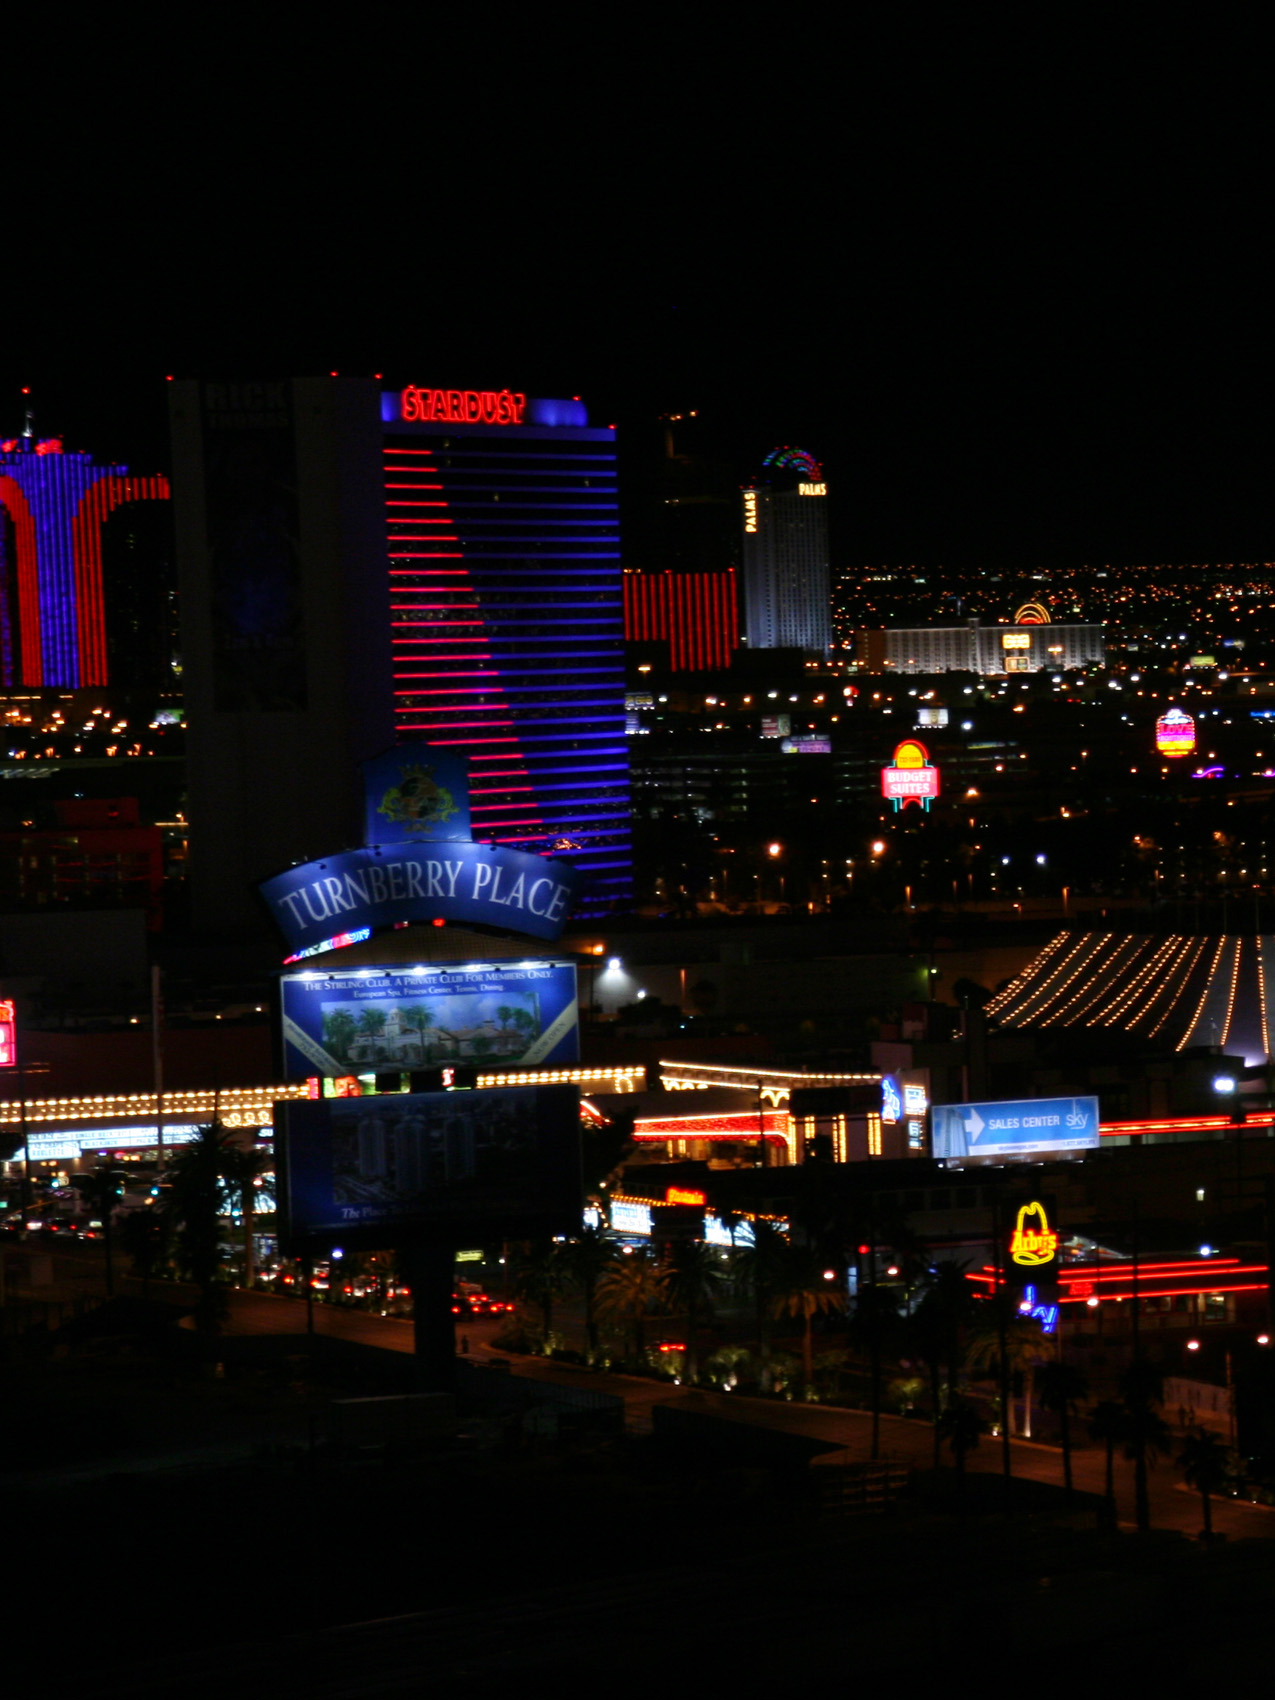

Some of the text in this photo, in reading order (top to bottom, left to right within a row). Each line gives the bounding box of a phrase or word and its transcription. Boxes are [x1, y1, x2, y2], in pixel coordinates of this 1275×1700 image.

[206, 384, 287, 409] RICK
[402, 386, 525, 424] STARDUST
[798, 482, 827, 496] PALMS
[744, 492, 758, 533] PALMS
[1160, 723, 1191, 735] LOVE
[888, 772, 932, 783] BUDGET
[890, 783, 930, 794] SUITES
[278, 860, 571, 930] TURNBERRY PLACE
[304, 982, 322, 991] THE
[325, 980, 364, 989] STIRLING
[394, 978, 402, 986] A
[404, 976, 437, 986] PRIVATE
[440, 974, 463, 984] CLUB
[465, 973, 484, 982] FOR
[486, 971, 526, 981] MEMBERS
[353, 990, 386, 999] European
[988, 1115, 1061, 1130] SALES CENTER
[341, 1207, 360, 1219] The
